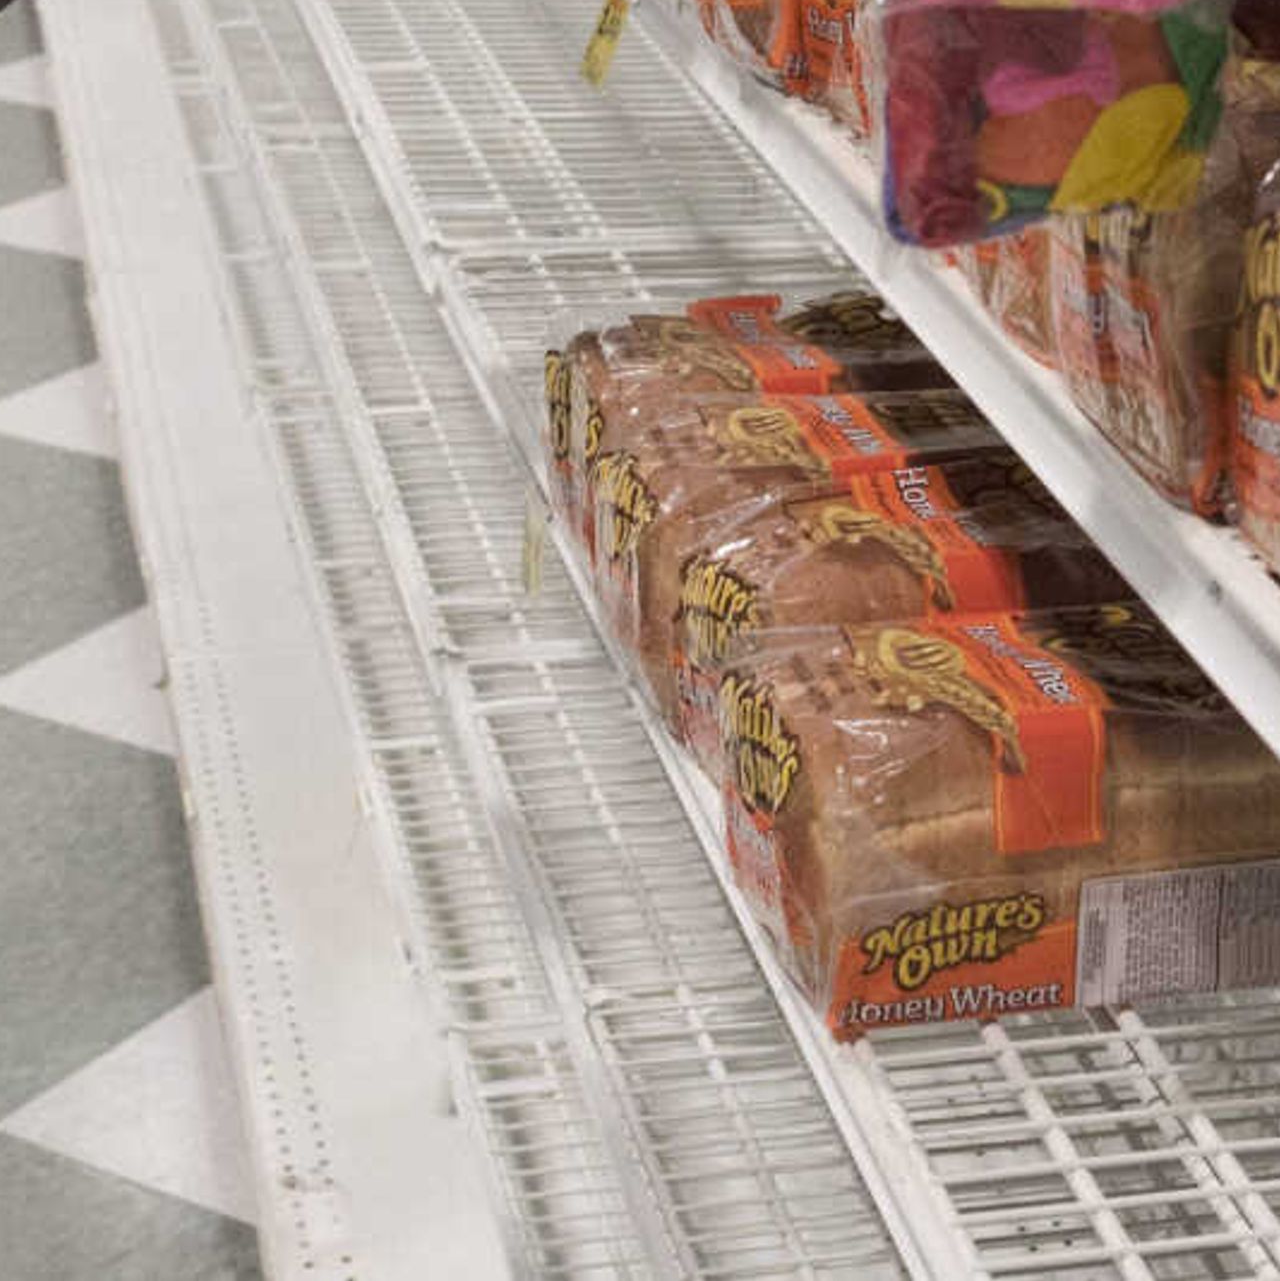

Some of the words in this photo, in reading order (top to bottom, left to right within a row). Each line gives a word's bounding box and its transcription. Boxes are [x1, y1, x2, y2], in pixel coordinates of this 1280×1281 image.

[862, 893, 1044, 975] Nature's
[895, 927, 1000, 990] Own
[949, 982, 1064, 1015] Wheat
